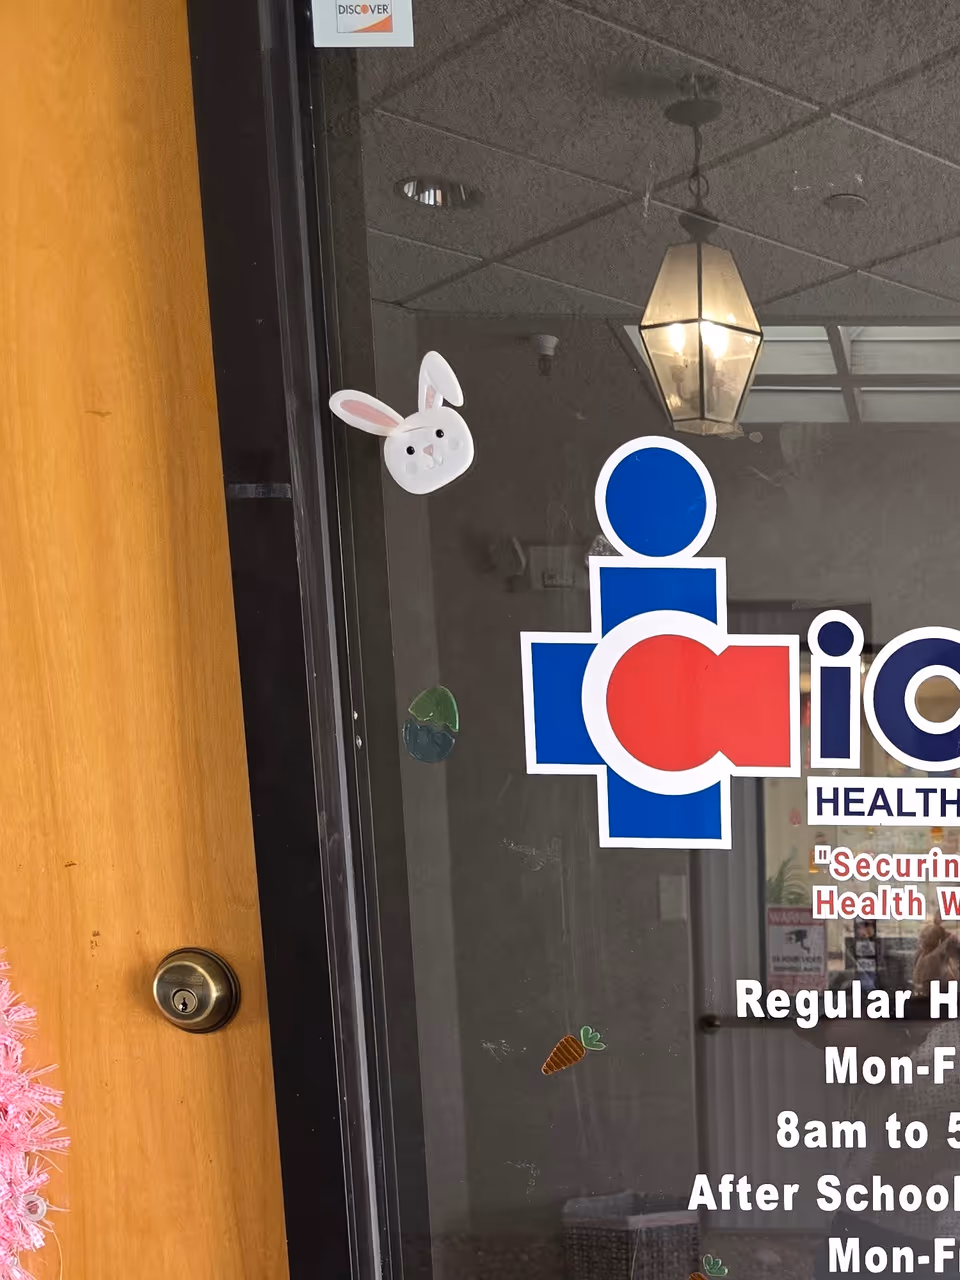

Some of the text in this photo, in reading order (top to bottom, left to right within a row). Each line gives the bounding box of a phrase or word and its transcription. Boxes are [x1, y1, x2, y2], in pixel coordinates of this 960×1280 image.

[338, 4, 390, 14] DISCOVER
[816, 889, 923, 917] Health
[736, 979, 912, 1029] Regular
[776, 1110, 867, 1149] 8am
[885, 1112, 929, 1149] to
[687, 1173, 800, 1211] After
